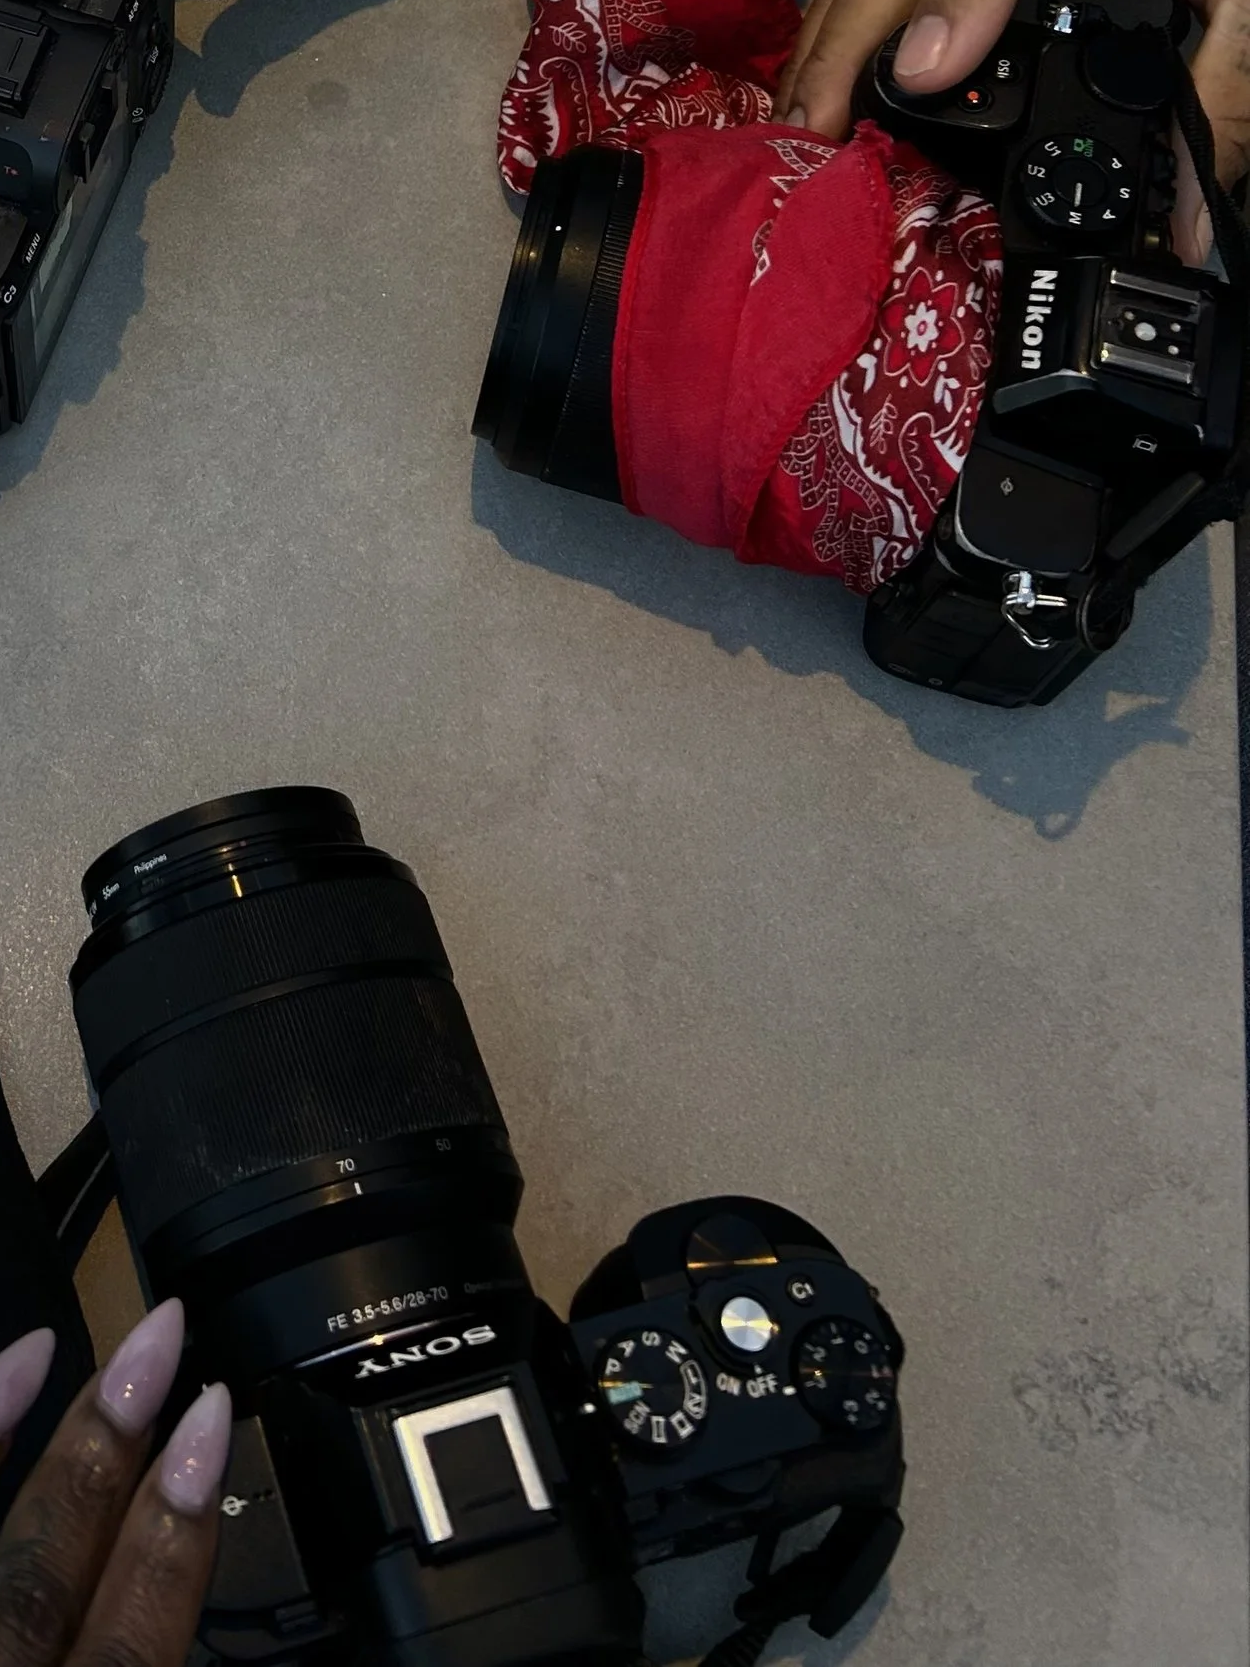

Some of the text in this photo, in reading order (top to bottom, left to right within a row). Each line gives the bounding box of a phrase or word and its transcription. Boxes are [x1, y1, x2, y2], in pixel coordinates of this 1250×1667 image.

[996, 58, 1011, 80] ISO
[1043, 140, 1063, 158] U1
[1026, 163, 1048, 179] U2
[1034, 191, 1056, 207] U3
[1118, 186, 1132, 200] S
[24, 232, 42, 265] MENU
[2, 283, 18, 305] C3
[1020, 269, 1059, 371] Nikon
[435, 1137, 452, 1153] 50
[335, 1157, 356, 1175] 70
[326, 1311, 349, 1334] FE
[351, 1284, 449, 1324] 3.5-5.6/28-70
[352, 1323, 498, 1380] SONY
[715, 1371, 742, 1396] ON
[745, 1373, 778, 1399] OFF
